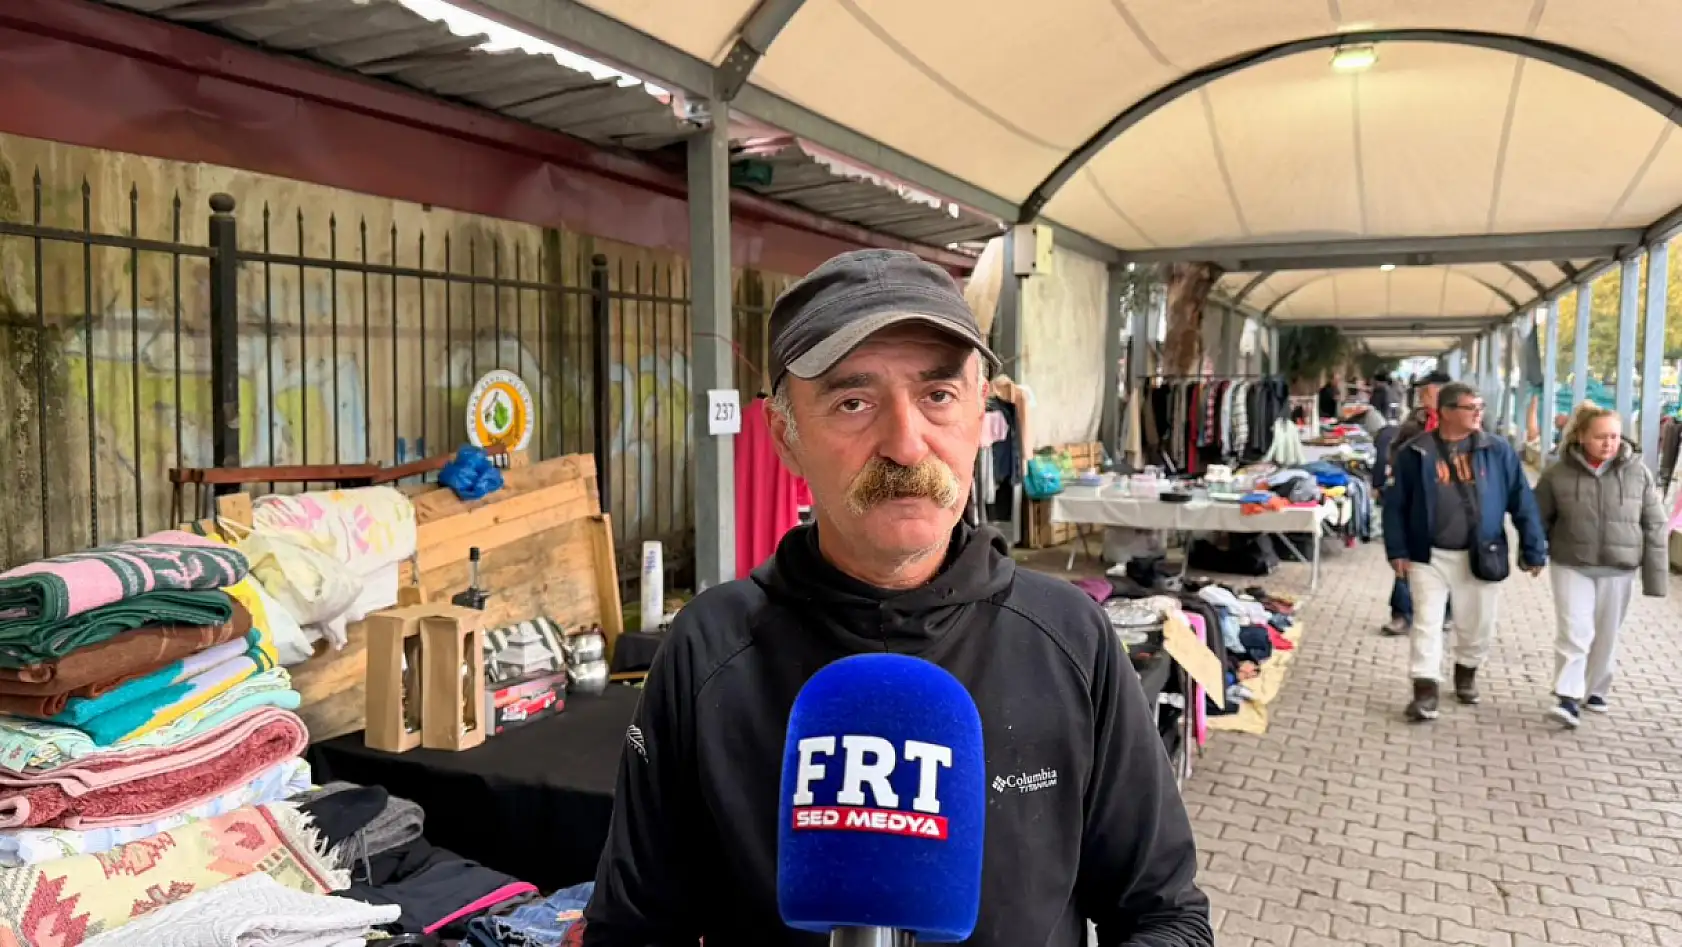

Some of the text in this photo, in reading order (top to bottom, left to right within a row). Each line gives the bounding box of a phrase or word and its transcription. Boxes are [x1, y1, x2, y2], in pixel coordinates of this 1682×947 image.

[715, 402, 733, 421] 237
[793, 735, 952, 814] FRT
[1006, 767, 1057, 788] Columbia
[796, 809, 940, 836] SED MEDYA
